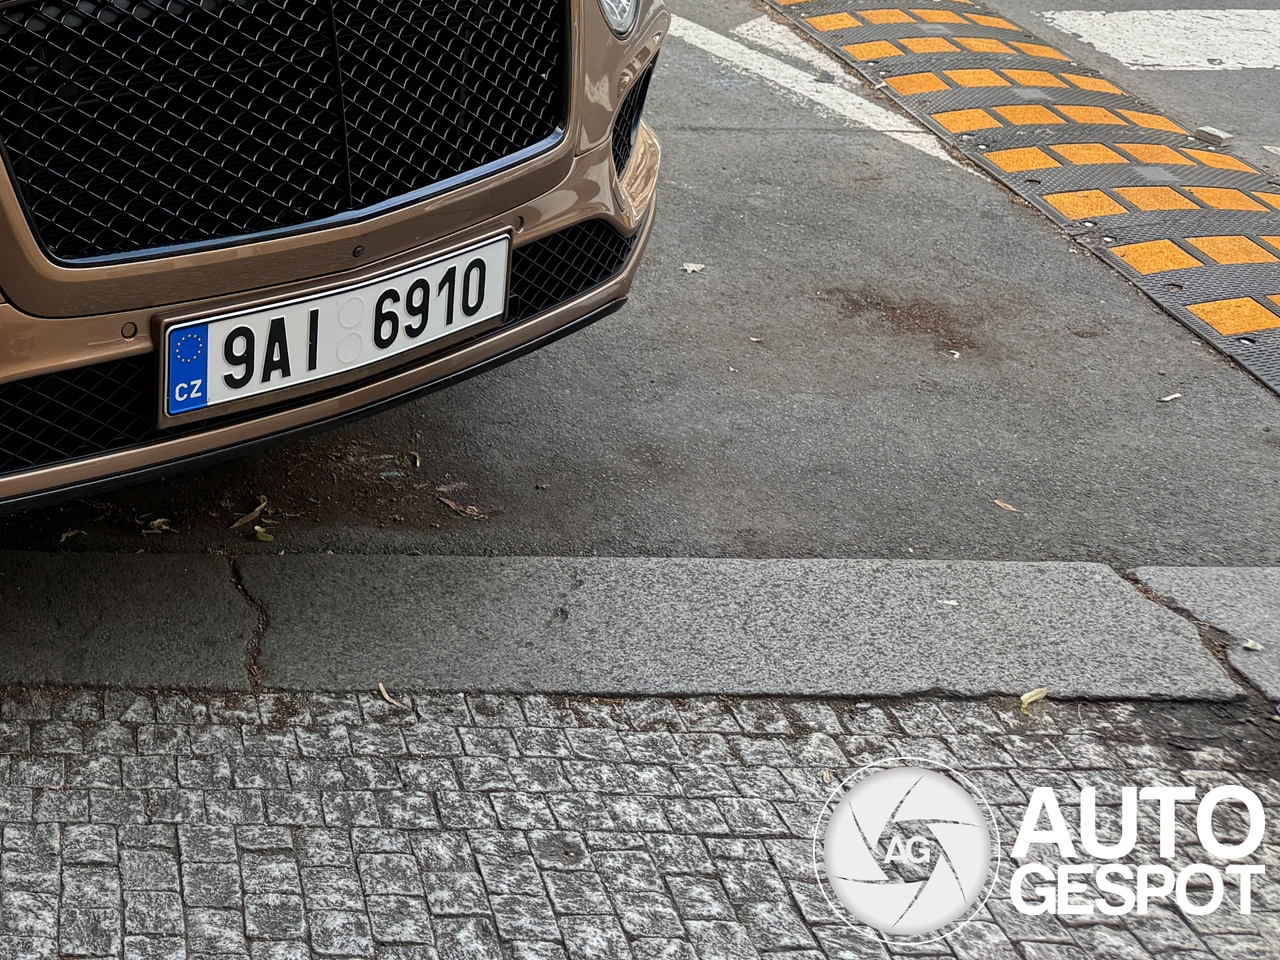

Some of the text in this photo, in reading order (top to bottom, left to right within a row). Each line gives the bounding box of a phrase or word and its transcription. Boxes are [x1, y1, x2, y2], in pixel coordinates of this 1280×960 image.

[222, 256, 487, 390] 9AI 6910
[174, 378, 203, 403] CZ
